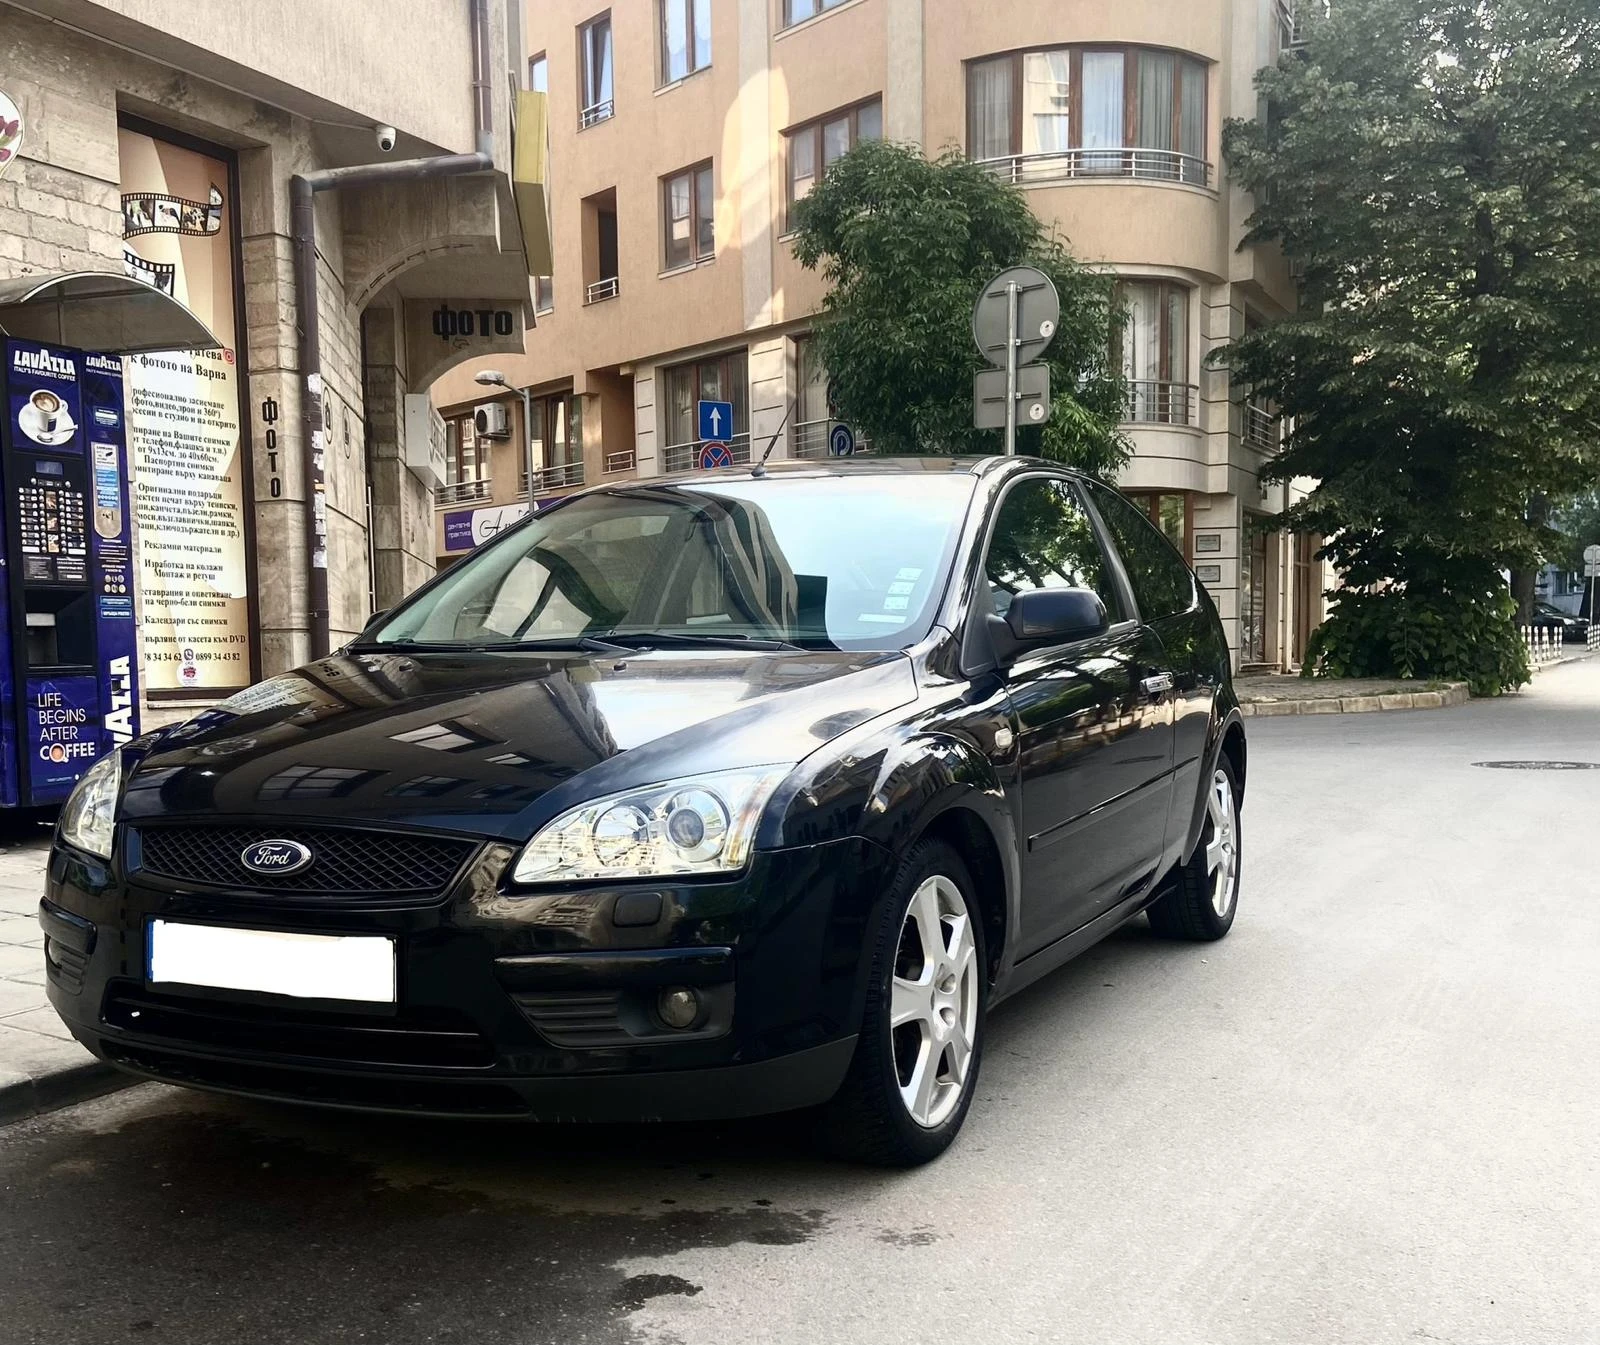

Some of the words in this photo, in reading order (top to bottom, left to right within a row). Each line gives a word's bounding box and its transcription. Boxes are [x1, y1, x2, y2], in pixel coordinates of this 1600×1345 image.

[14, 349, 76, 375] LAVAZZA
[190, 350, 222, 360] атева
[86, 356, 122, 372] LAVAZZA
[140, 354, 178, 371] фотото
[180, 364, 192, 374] на
[196, 364, 226, 380] Варна
[32, 369, 57, 378] FAVOURITE
[132, 388, 187, 403] рофесионално
[164, 412, 190, 423] студио
[208, 420, 236, 429] открито
[162, 430, 172, 438] на
[174, 430, 202, 442] Вашите
[204, 437, 230, 446] снимки
[138, 446, 146, 454] от
[187, 462, 214, 472] снимки
[144, 540, 182, 550] Рекламни
[184, 546, 222, 554] материали
[144, 559, 184, 570] Изработка
[196, 564, 223, 572] колажи
[154, 569, 184, 578] Монтаж
[193, 572, 216, 582] ретуш
[145, 598, 154, 606] на
[156, 598, 197, 608] черно-бели
[200, 600, 226, 608] снимки
[145, 616, 186, 626] Календари
[230, 635, 246, 643] DVD
[38, 693, 62, 708] LIFE
[105, 656, 133, 749] VAZZA
[39, 708, 86, 724] BEGINS
[40, 726, 78, 742] AFTER
[40, 742, 95, 763] COFFEE
[255, 846, 291, 864] Ford
